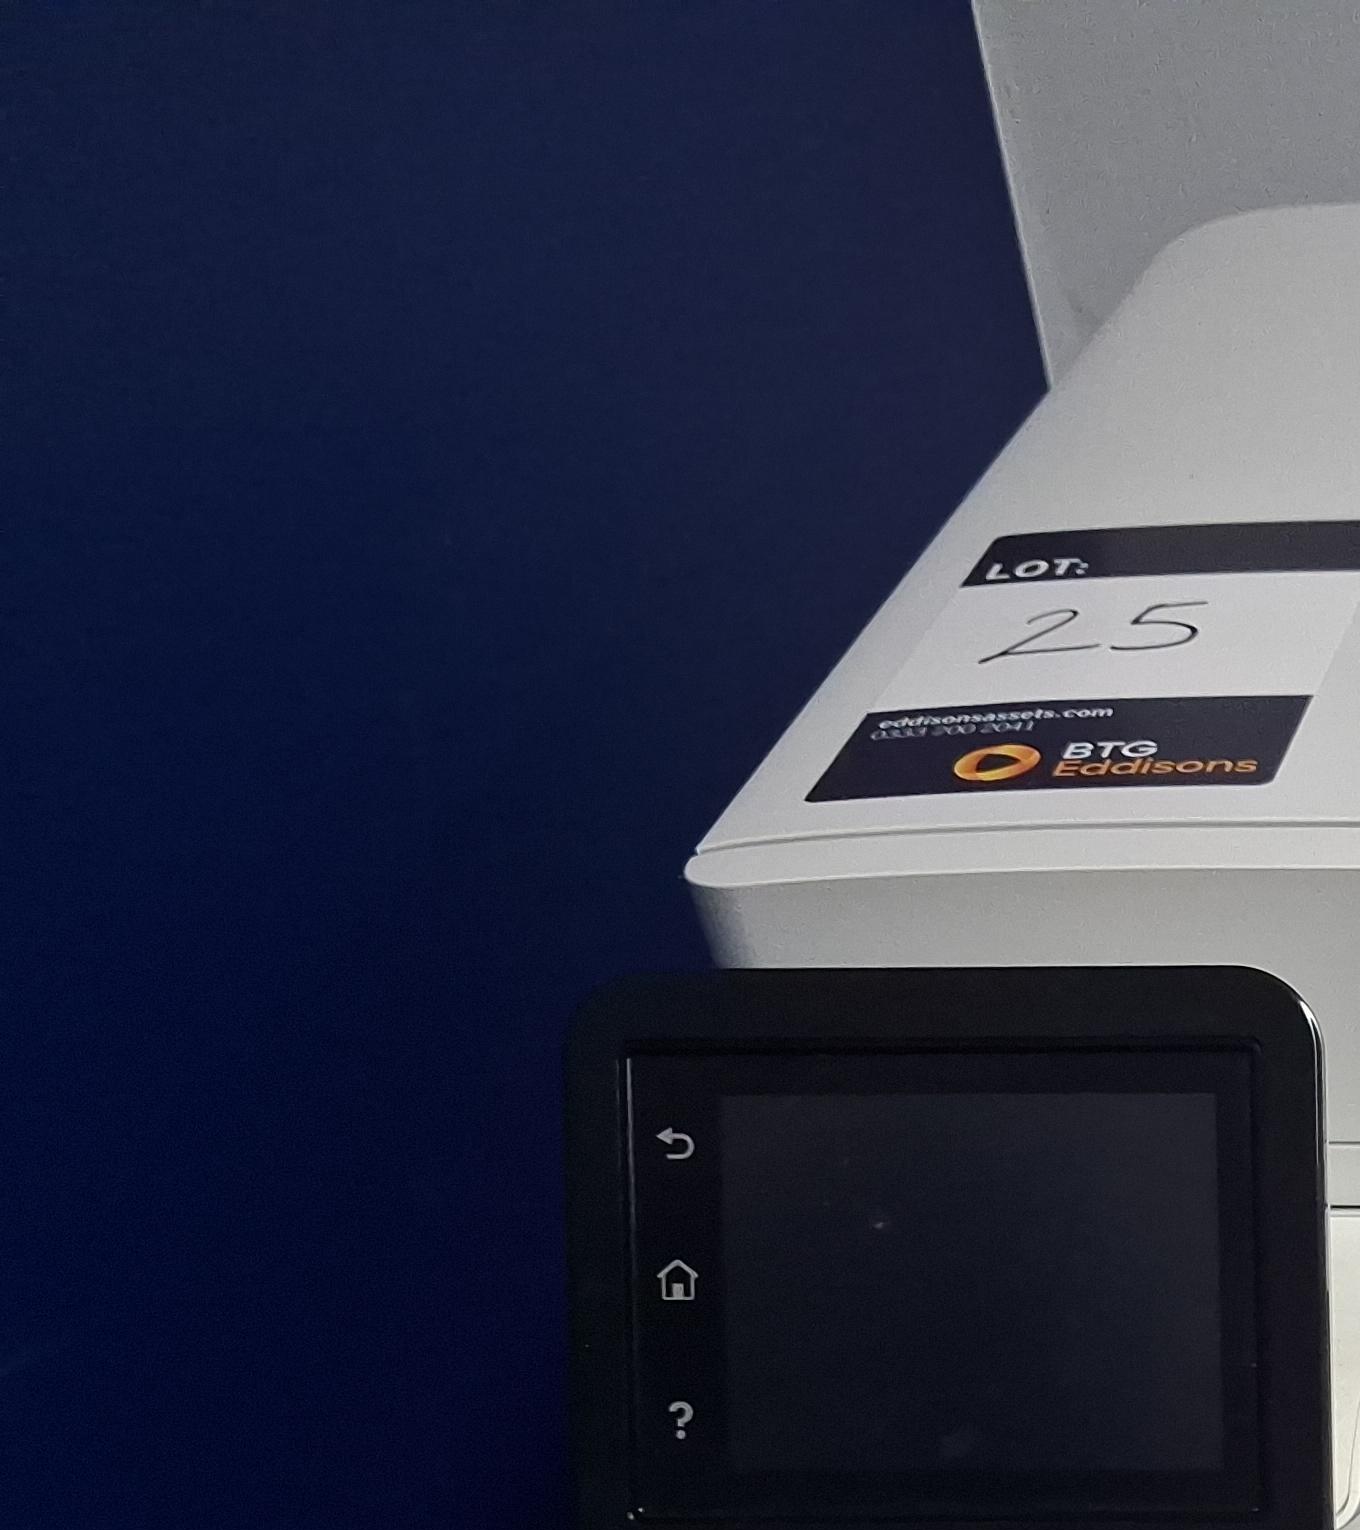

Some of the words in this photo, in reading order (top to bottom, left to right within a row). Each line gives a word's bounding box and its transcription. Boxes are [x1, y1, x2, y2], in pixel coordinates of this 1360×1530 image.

[985, 557, 1089, 581] LOT:
[978, 601, 1208, 664] 25
[879, 707, 1114, 731] eddisonsassets.com
[1062, 740, 1158, 760] BTG
[1053, 757, 1259, 777] Eddisons
